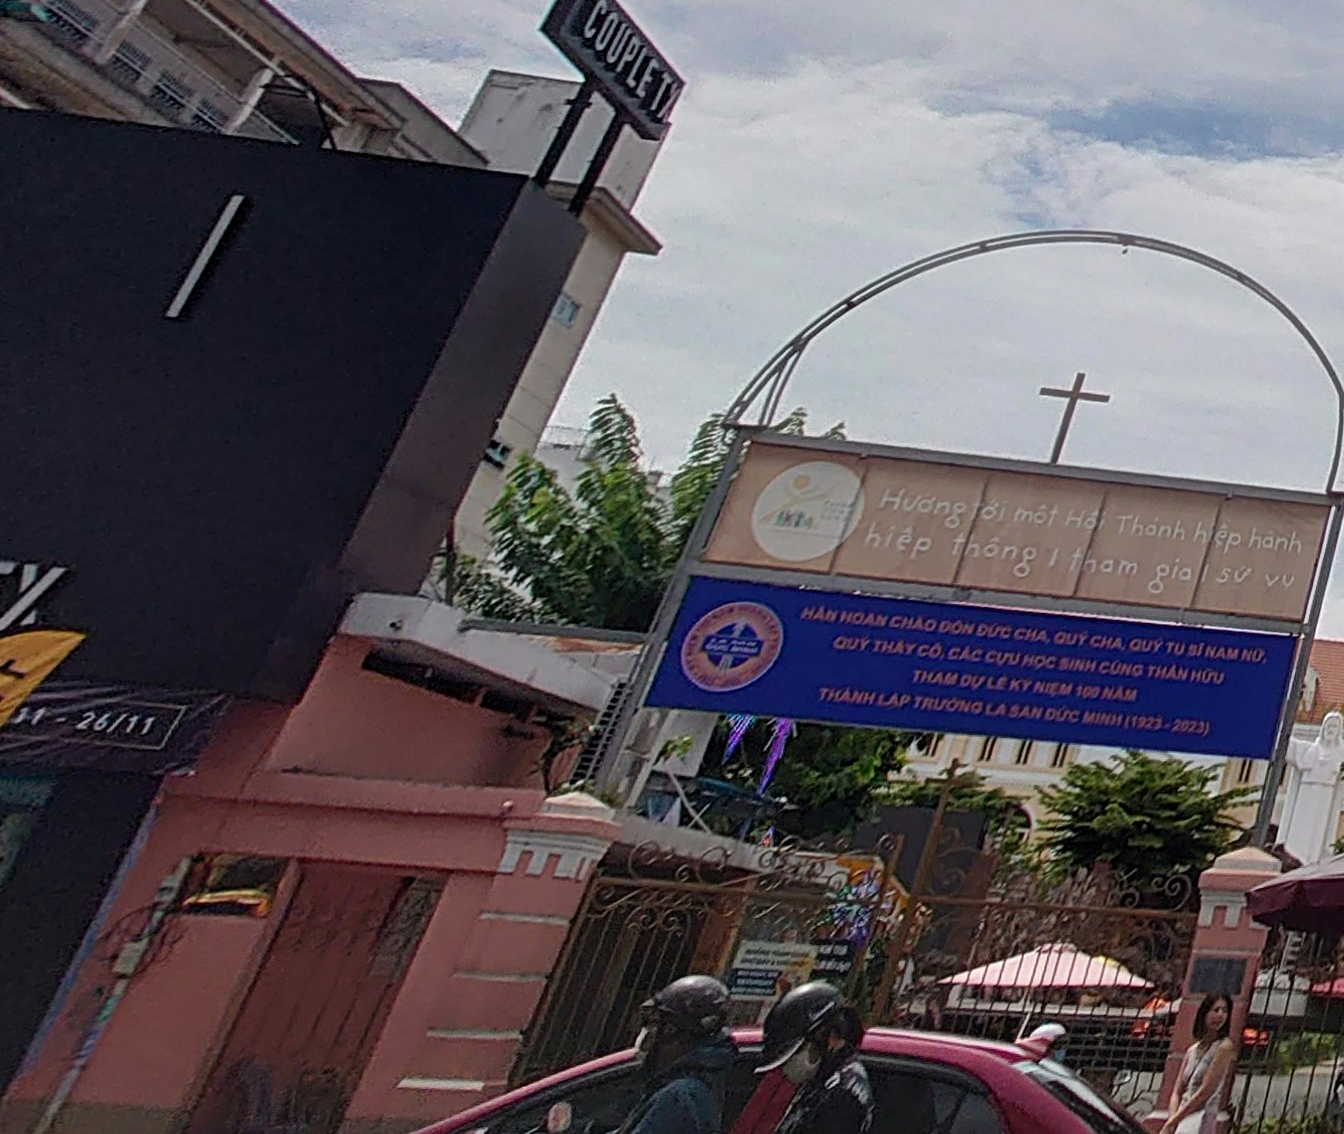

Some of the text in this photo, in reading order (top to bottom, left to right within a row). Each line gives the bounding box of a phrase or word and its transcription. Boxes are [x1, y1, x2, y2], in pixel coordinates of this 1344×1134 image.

[584, 0, 661, 98] COUPLE
[1117, 514, 1186, 542] Thánh
[1248, 527, 1302, 554] hành
[864, 521, 932, 559] hiệp
[951, 531, 1038, 577] thông
[1070, 547, 1138, 576] tham
[1148, 558, 1193, 594] gia
[840, 611, 889, 627] HOAN
[1205, 645, 1240, 661] NAM
[913, 669, 958, 686] THAM
[1059, 658, 1097, 673] SINH
[75, 711, 157, 735] 26/11
[985, 702, 1006, 716] LA
[1008, 705, 1043, 719] SAN
[1081, 710, 1123, 727] MINH
[1171, 718, 1211, 737] 2023)
